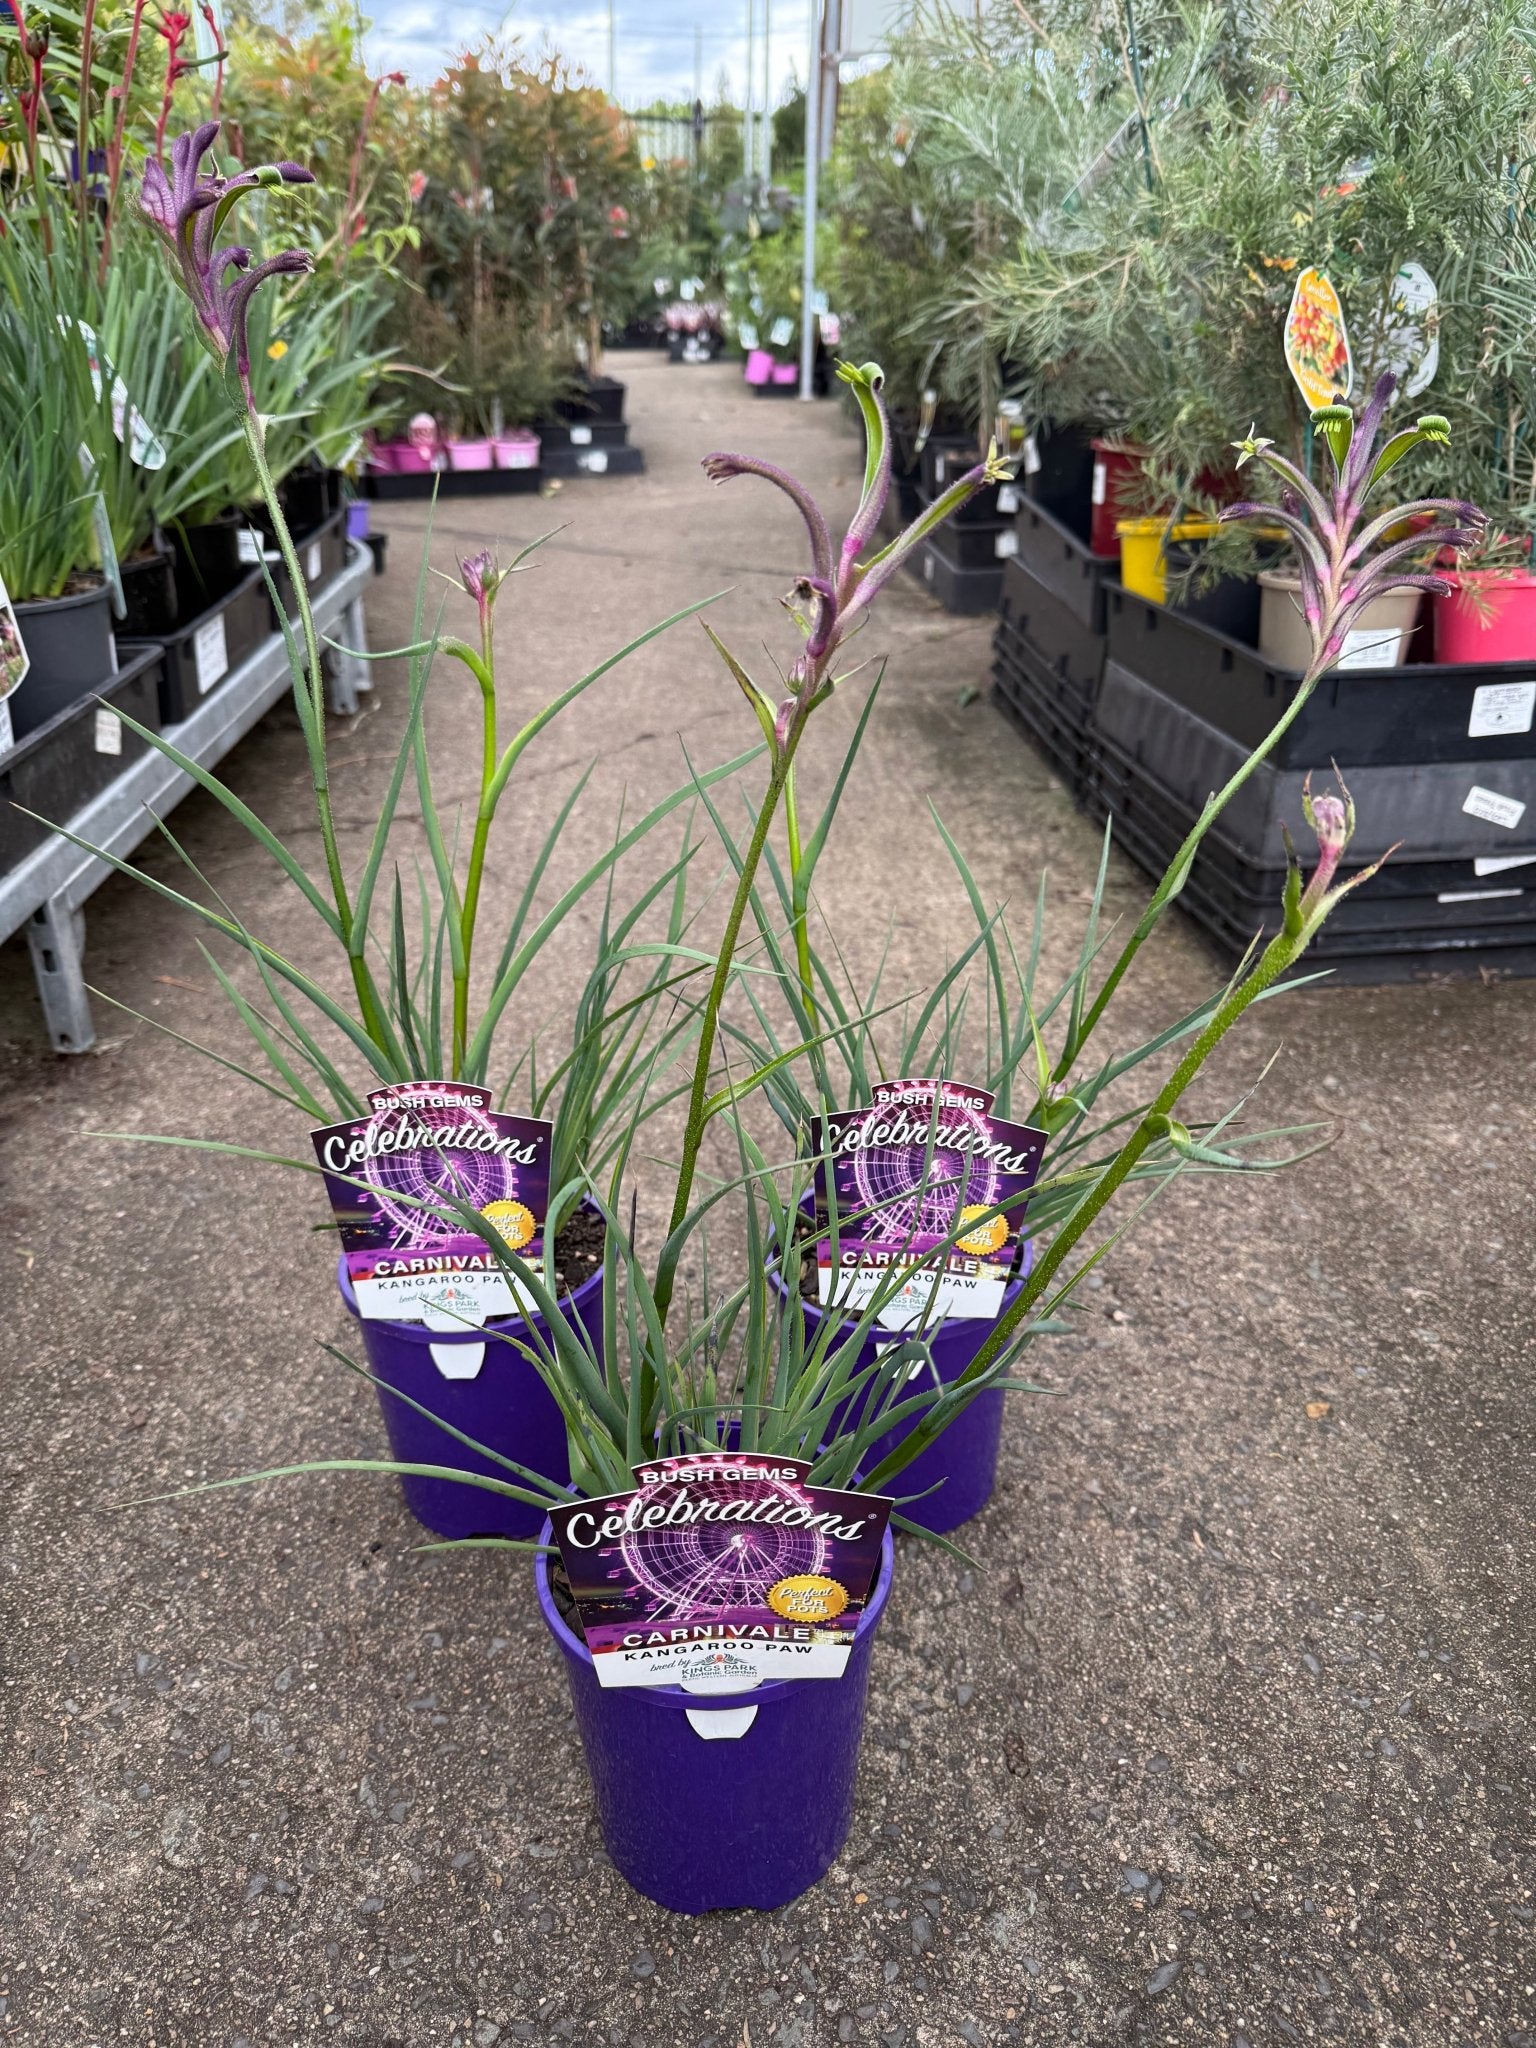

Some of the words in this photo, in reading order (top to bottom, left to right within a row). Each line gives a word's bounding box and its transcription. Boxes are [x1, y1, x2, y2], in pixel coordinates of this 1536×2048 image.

[372, 1096, 426, 1109] BUSH
[430, 1095, 484, 1107] GEMS
[878, 1092, 927, 1105] BUSH
[324, 1114, 537, 1172] Celebrations
[971, 1229, 991, 1238] OR
[962, 1236, 993, 1246] POTS
[374, 1255, 511, 1275] CARNIVAL
[378, 1275, 474, 1290] KANGAROO
[943, 1277, 977, 1288] PAW
[642, 1471, 715, 1484] BUSH
[722, 1467, 797, 1481] GEMS
[566, 1488, 865, 1549] Celebrations
[780, 1587, 834, 1601] Perfect
[787, 1605, 829, 1613] POTS
[623, 1624, 811, 1647] CARNIVALE
[624, 1642, 754, 1661] KANGAROO
[765, 1644, 813, 1654] PAW
[650, 1660, 676, 1672] bred
[677, 1658, 691, 1668] by
[682, 1664, 721, 1675] KINGS
